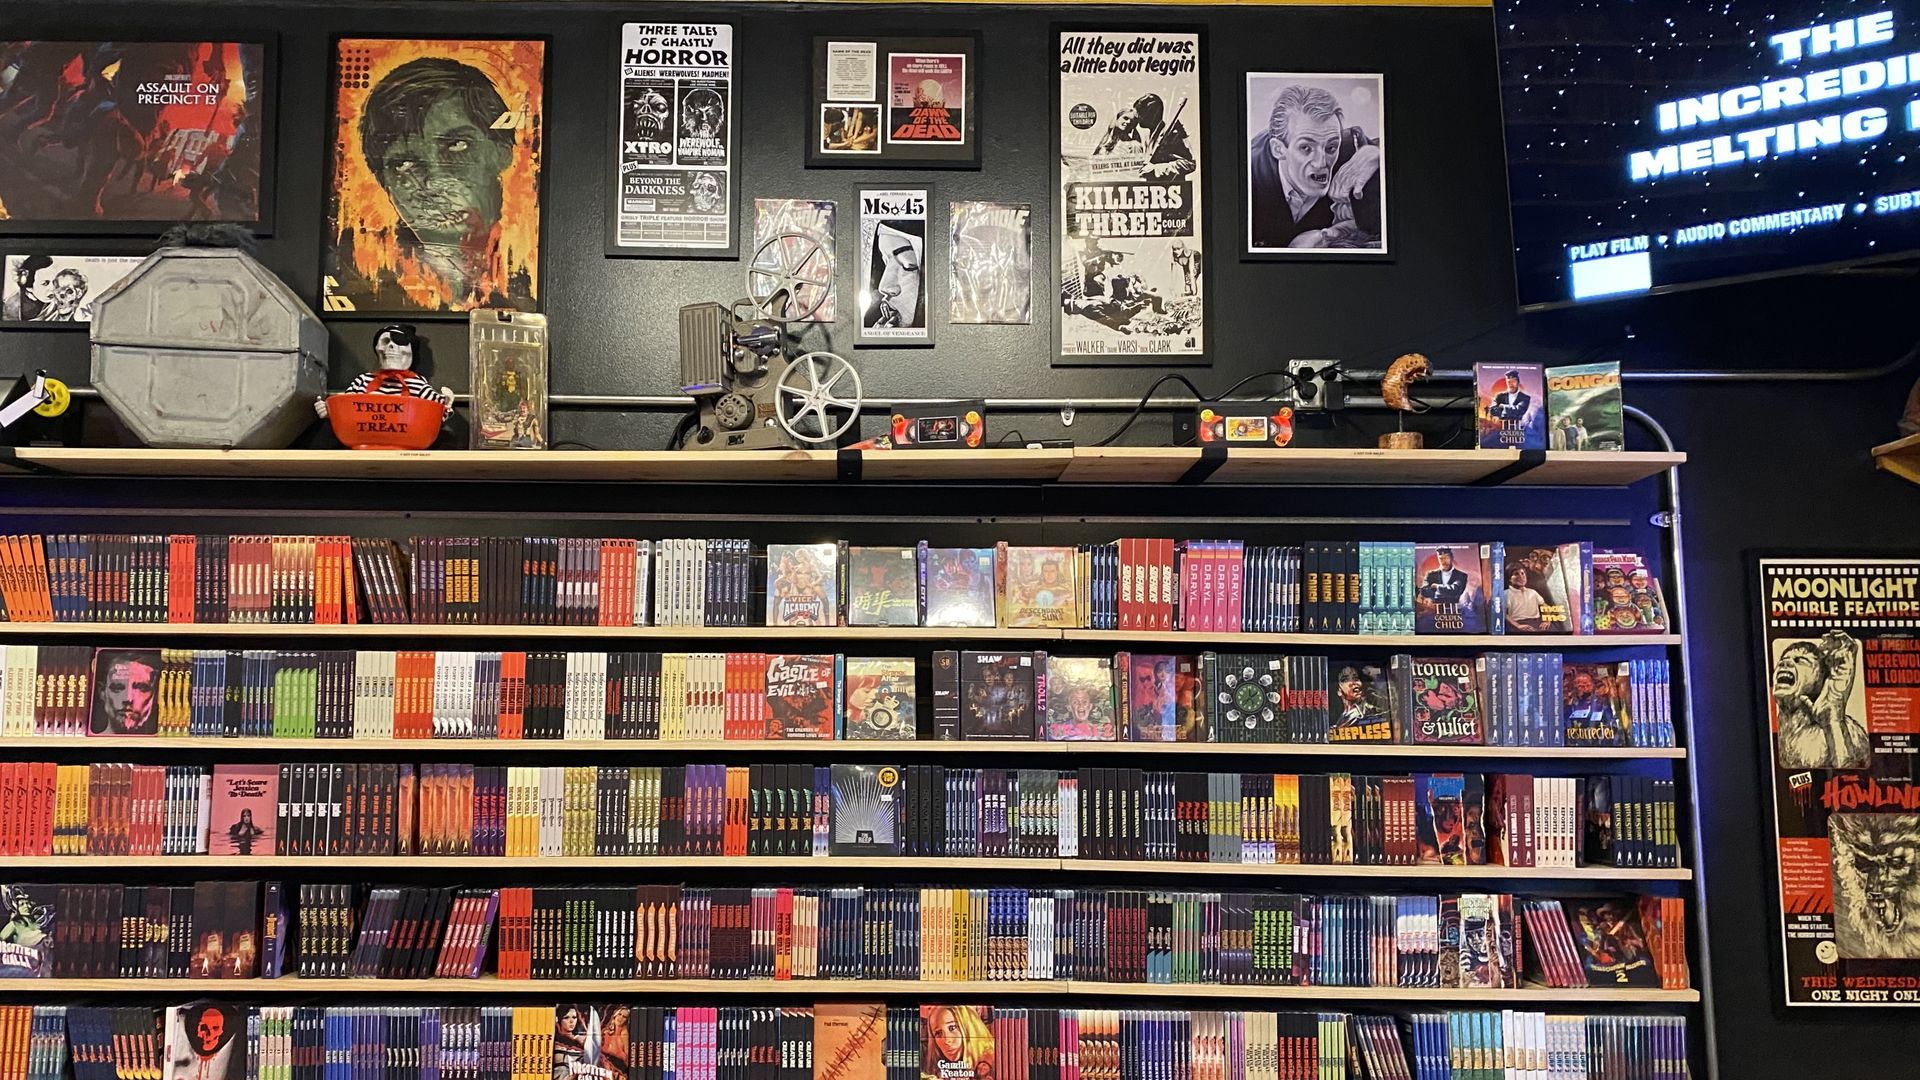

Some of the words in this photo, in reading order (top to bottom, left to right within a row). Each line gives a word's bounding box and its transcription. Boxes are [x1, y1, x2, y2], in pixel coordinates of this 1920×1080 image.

[639, 25, 677, 35] THREE
[682, 26, 718, 36] TALES
[640, 37, 657, 46] OF
[662, 38, 714, 47] GHASTLY
[1770, 11, 1894, 64] THE
[1062, 36, 1085, 55] All
[1087, 35, 1126, 57] they
[1127, 37, 1156, 54] did
[1157, 40, 1194, 54] was
[624, 49, 728, 65] HORROR
[1061, 59, 1072, 73] a
[1072, 56, 1107, 74] little
[1109, 57, 1145, 73] boot
[634, 69, 656, 77] ALIENS!
[136, 82, 192, 94] ASSAULT
[196, 83, 219, 94] ON
[138, 94, 199, 105] PRECINCT
[205, 95, 217, 105] 13
[909, 108, 950, 117] DAWN
[913, 116, 928, 125] OF
[928, 116, 949, 125] THE
[892, 124, 961, 139] DEAD
[624, 141, 672, 154] XTRO
[679, 138, 720, 149] WEREWOLF
[1631, 107, 1888, 181] MELTING
[622, 162, 637, 172] PLUS
[629, 177, 663, 185] BEYOND
[664, 177, 681, 185] THE
[625, 185, 685, 195] DARKNESS
[1074, 185, 1183, 210] KILLERS
[1075, 212, 1162, 237] THREE
[1162, 218, 1187, 229] COLOR
[1570, 240, 1608, 260] PLAY
[1611, 236, 1649, 255] FILM
[1675, 224, 1726, 245] AUDIO
[1729, 203, 1846, 236] COMMENTARY
[480, 328, 540, 344] ALIENS
[1076, 340, 1105, 353] WALKER
[1117, 340, 1139, 353] VARSI
[1149, 340, 1171, 353] CLARK
[1548, 374, 1620, 392] CONGO
[353, 401, 404, 413] TRICK
[356, 421, 408, 434] TREAT
[1499, 419, 1526, 431] THE
[1499, 436, 1526, 444] CHILD
[1771, 577, 1918, 599] MOONLIGHT
[783, 602, 820, 620] ACADEMY
[1434, 603, 1462, 615] THE
[1772, 601, 1839, 617] DOUBLE
[1844, 601, 1920, 617] FEATURE
[1435, 620, 1464, 629] CHILD
[977, 655, 1002, 664] SHAW
[1411, 661, 1470, 677] tromeo
[1867, 669, 1880, 684] IN
[1037, 674, 1046, 704] TROLL
[1328, 723, 1391, 741] SLEEPLESS
[1436, 718, 1477, 737] juliet
[1567, 726, 1614, 740] resurrected
[1791, 774, 1810, 787] PLUS
[1616, 972, 1628, 983] 2
[1801, 976, 1837, 988] THIS
[1811, 990, 1842, 1002] ONE
[1845, 990, 1889, 1002] NIGHT
[684, 1022, 692, 1046] STEEL
[568, 1056, 613, 1077] FORGOTTEN
[937, 1059, 971, 1070] Camille
[941, 1069, 975, 1078] Keaton
